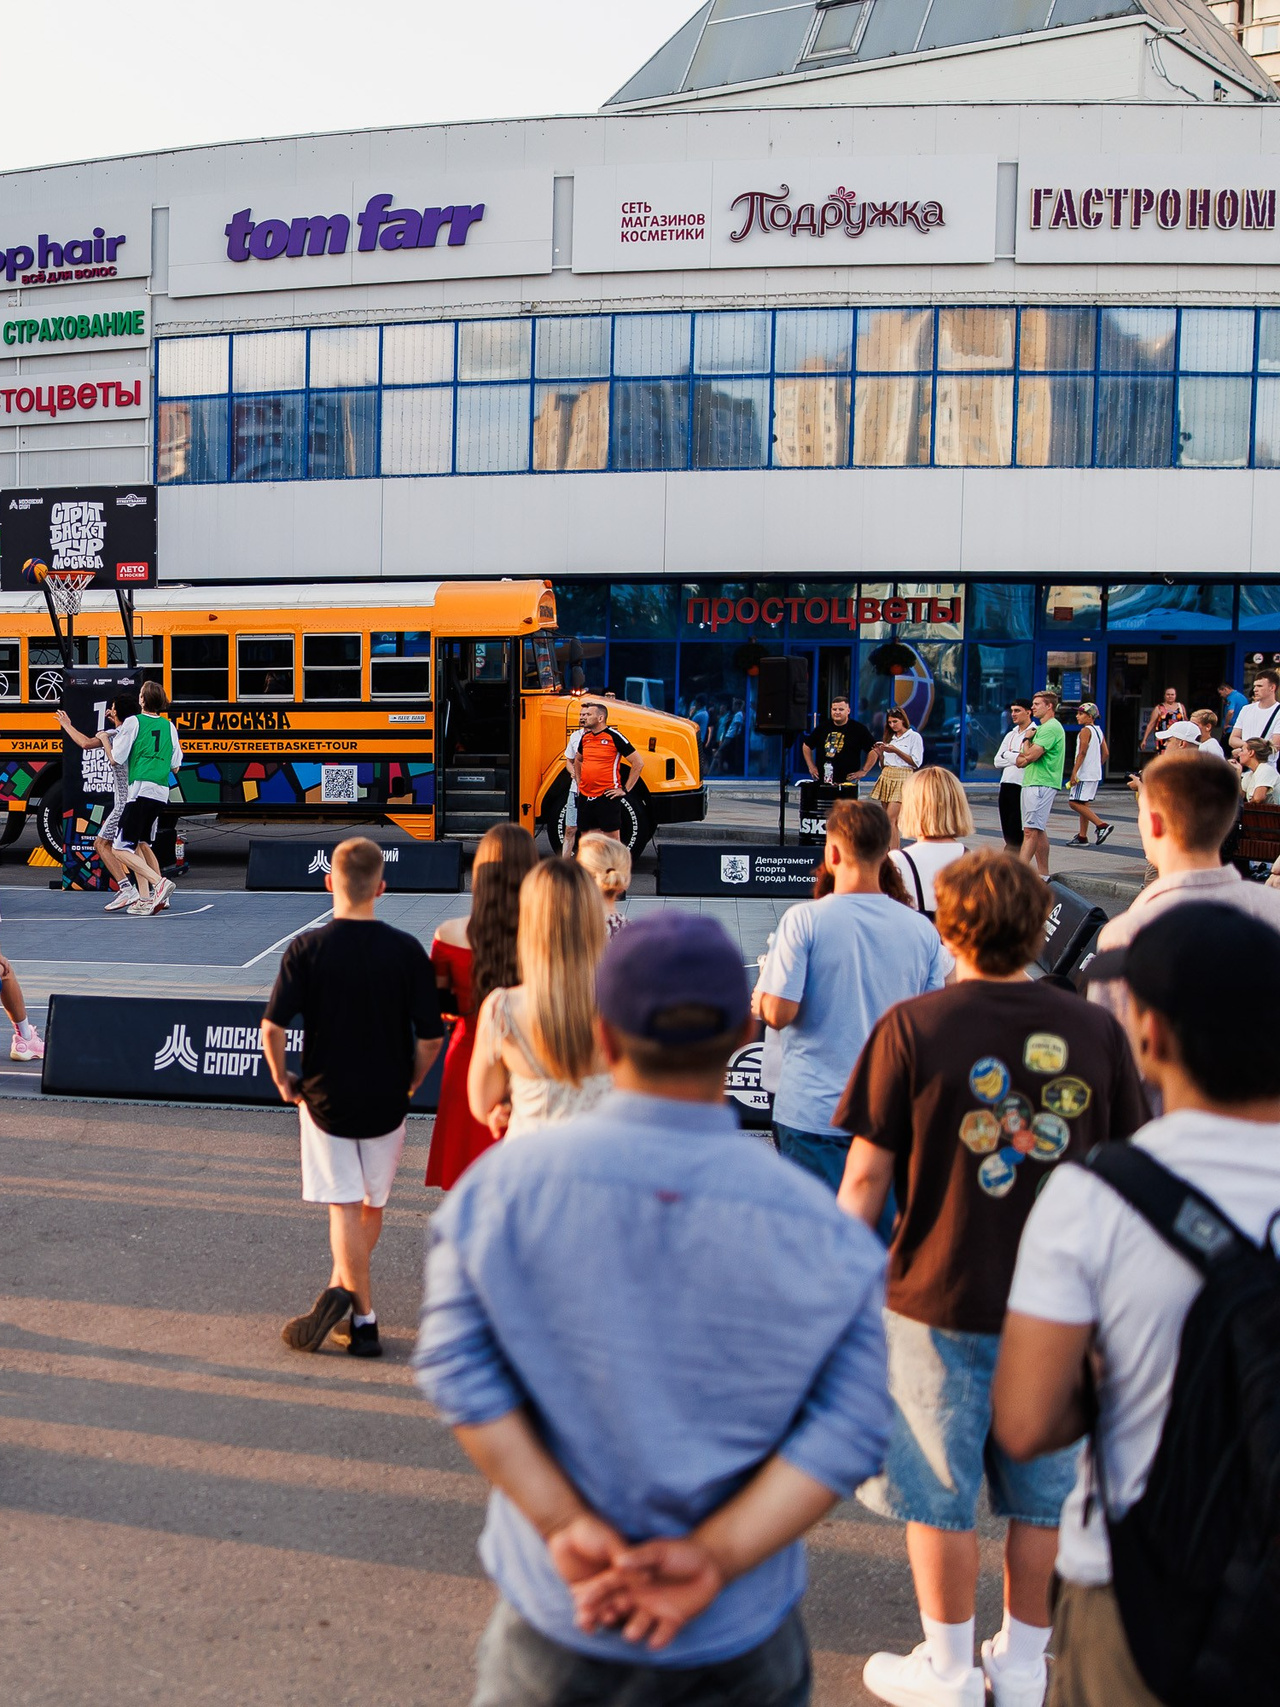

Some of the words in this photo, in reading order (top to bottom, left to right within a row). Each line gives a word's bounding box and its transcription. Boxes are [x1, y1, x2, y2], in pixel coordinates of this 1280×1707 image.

[621, 201, 652, 214] СЕТЬ
[729, 184, 946, 243] Подружка
[1030, 187, 1277, 230] ГАСТРОНОМ
[225, 208, 350, 262] tom
[357, 193, 486, 252] farr
[621, 213, 705, 228] МАГАЗИНОВ
[621, 228, 704, 243] КОСМЕТИКИ
[3, 310, 145, 345] СТРАХОВАНИЕ
[51, 501, 104, 526] СТРИТ
[49, 520, 107, 545] БАСКЕТ
[51, 538, 104, 557] ТУР
[51, 555, 104, 570] МОСКВА
[119, 565, 145, 573] ЛЕТО
[686, 596, 962, 633] простоцветы
[211, 711, 292, 730] МОСКВА
[11, 740, 48, 751] УЗНАЙ
[151, 730, 161, 753] 1
[181, 741, 358, 752] SKET.RU/STREETBASKET-TOUR
[81, 759, 112, 775] БАСК
[754, 856, 814, 866] Департамент
[755, 866, 786, 875] спорта
[755, 875, 786, 884] города
[205, 1025, 305, 1052] МОСКСК
[203, 1051, 262, 1077] СПОРТ
